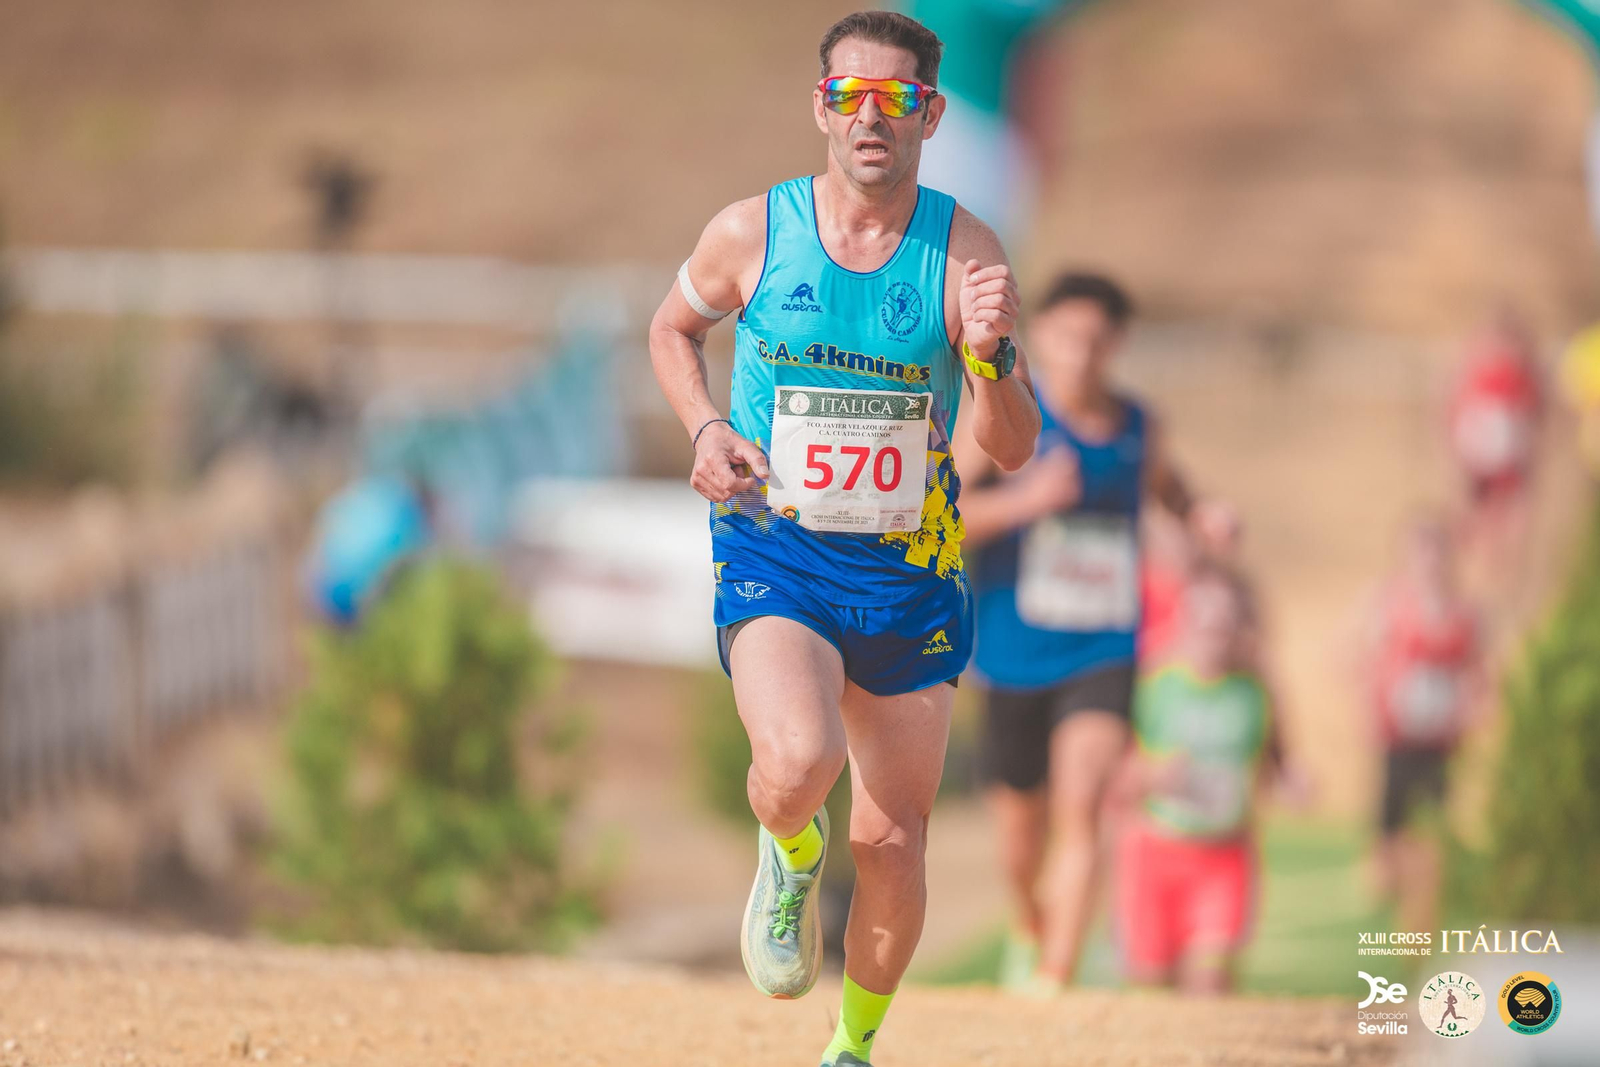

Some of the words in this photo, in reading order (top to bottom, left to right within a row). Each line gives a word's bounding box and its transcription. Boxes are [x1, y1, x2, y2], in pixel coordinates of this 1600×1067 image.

[758, 340, 800, 363] C.A.
[820, 395, 894, 415] ITÁLICA
[848, 424, 888, 432] VELAZQUEZ
[803, 444, 903, 492] 570
